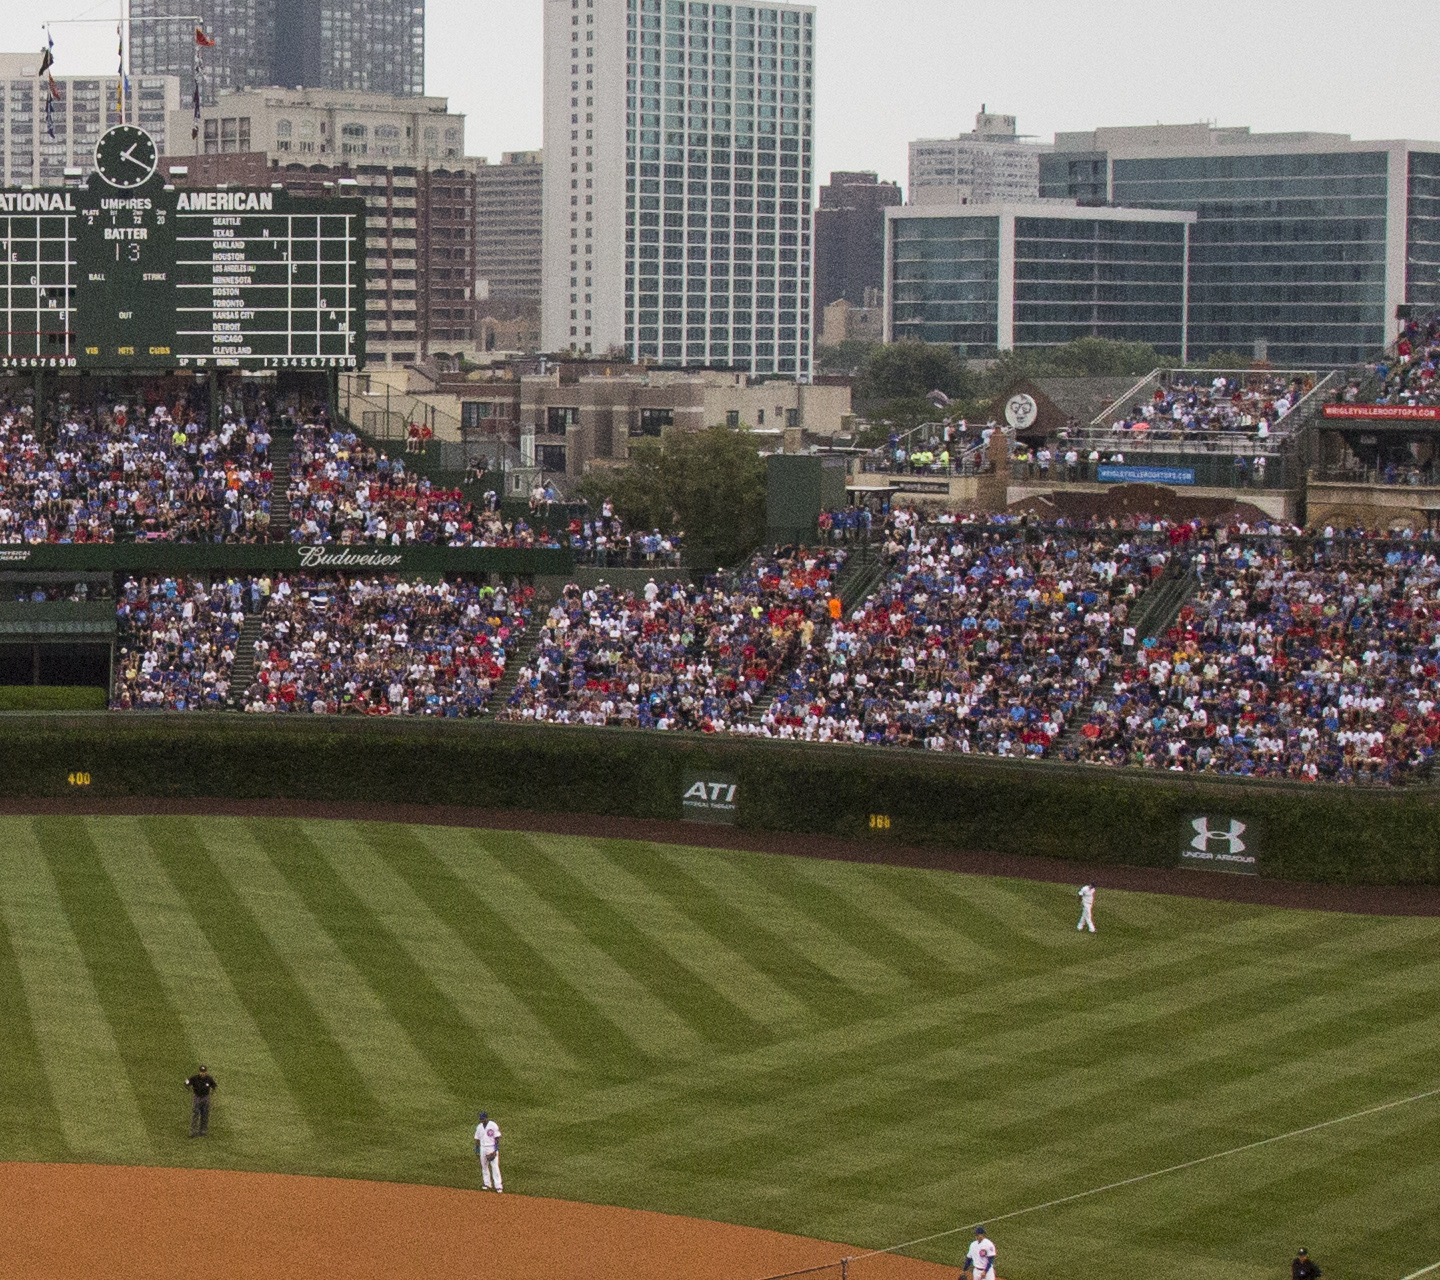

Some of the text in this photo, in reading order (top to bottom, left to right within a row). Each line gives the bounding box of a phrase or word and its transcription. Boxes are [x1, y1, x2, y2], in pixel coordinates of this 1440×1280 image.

[101, 199, 152, 209] UMPIRES
[177, 193, 272, 210] AMERICAN
[104, 228, 147, 239] BATTER
[298, 546, 402, 566] Budweiser
[68, 772, 90, 785] 400
[683, 781, 737, 802] ATI
[1182, 851, 1213, 859] UNDER
